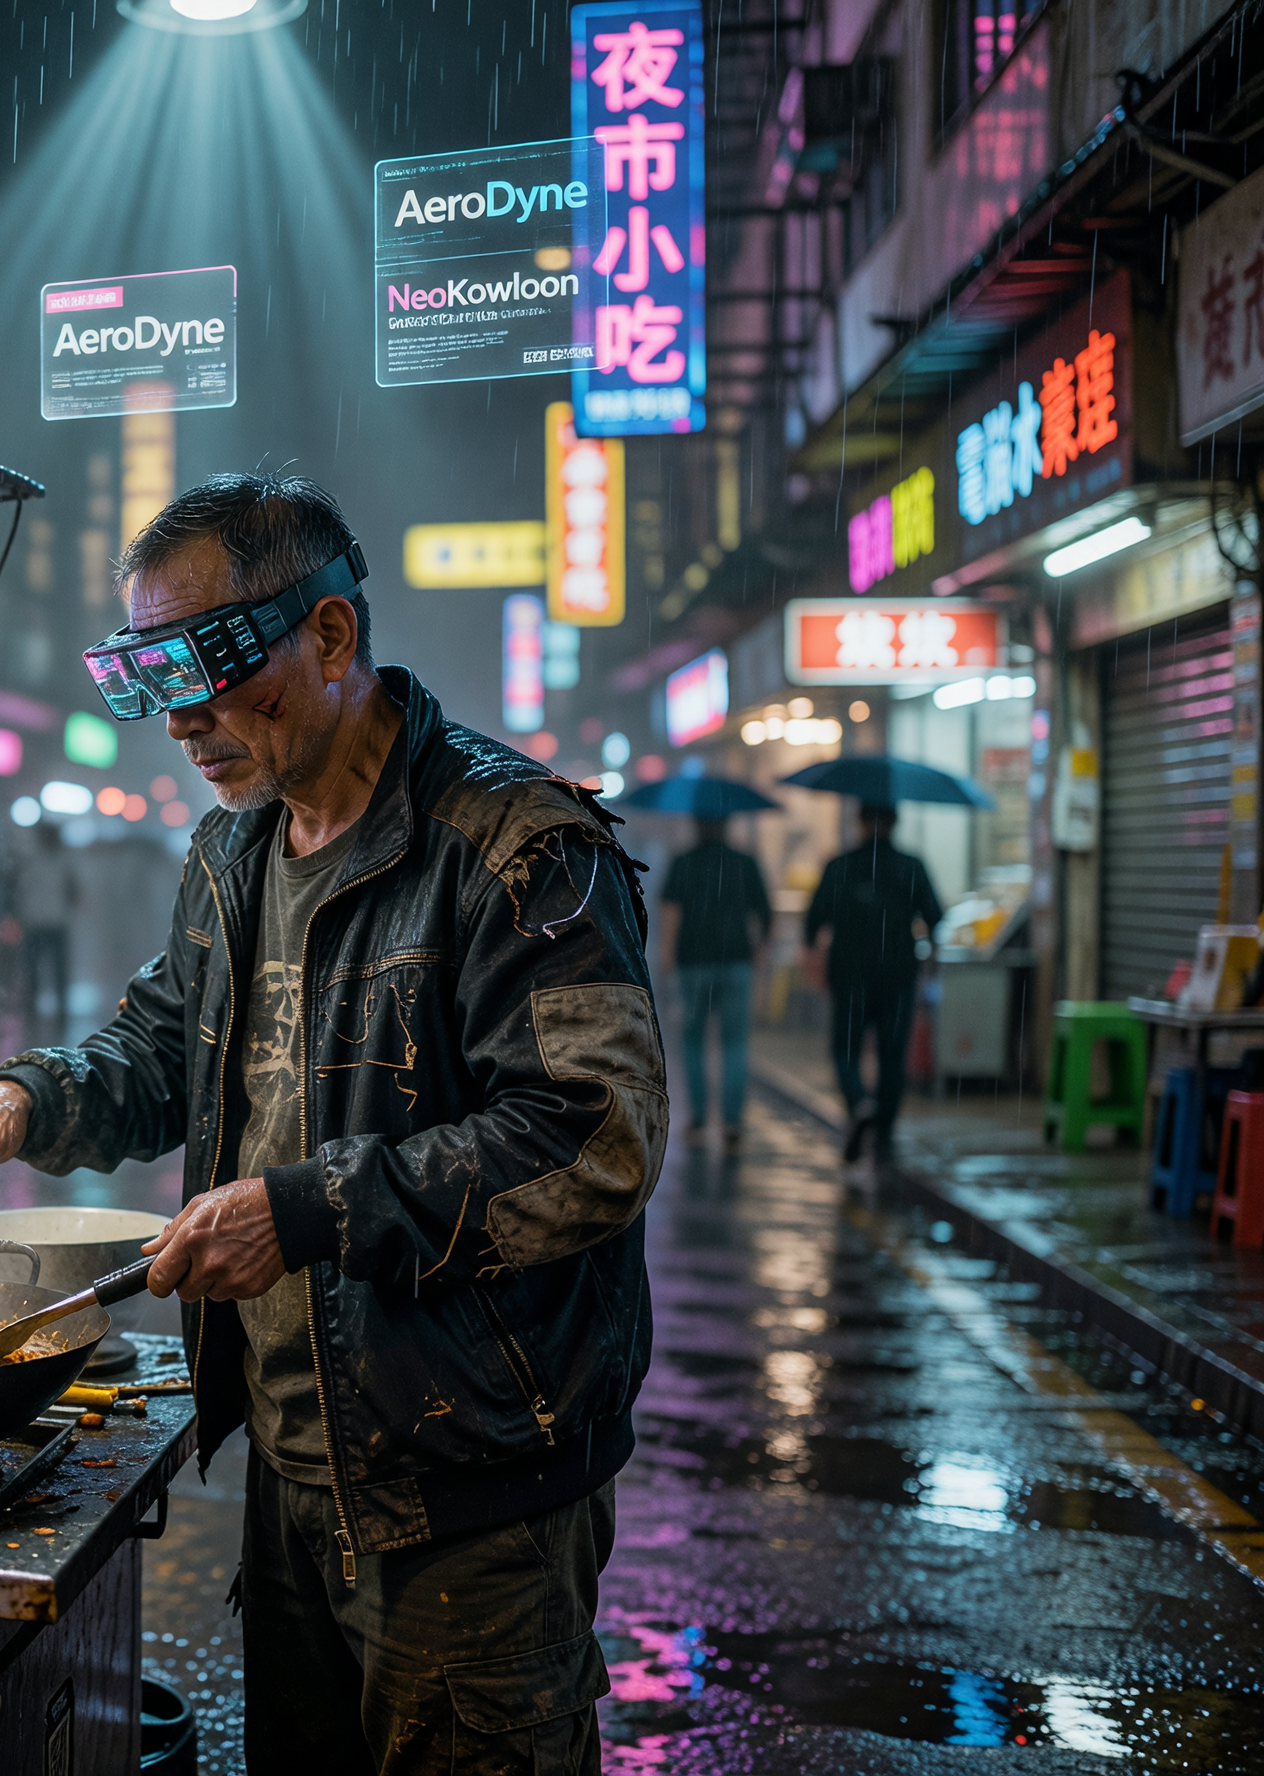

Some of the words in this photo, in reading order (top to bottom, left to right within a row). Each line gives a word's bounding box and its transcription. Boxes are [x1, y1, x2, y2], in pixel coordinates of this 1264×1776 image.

[393, 180, 589, 228] AeroDyne
[590, 21, 686, 383] 夜市小吃
[388, 271, 580, 313] NeoKowloon
[52, 315, 226, 357] AeroDyne
